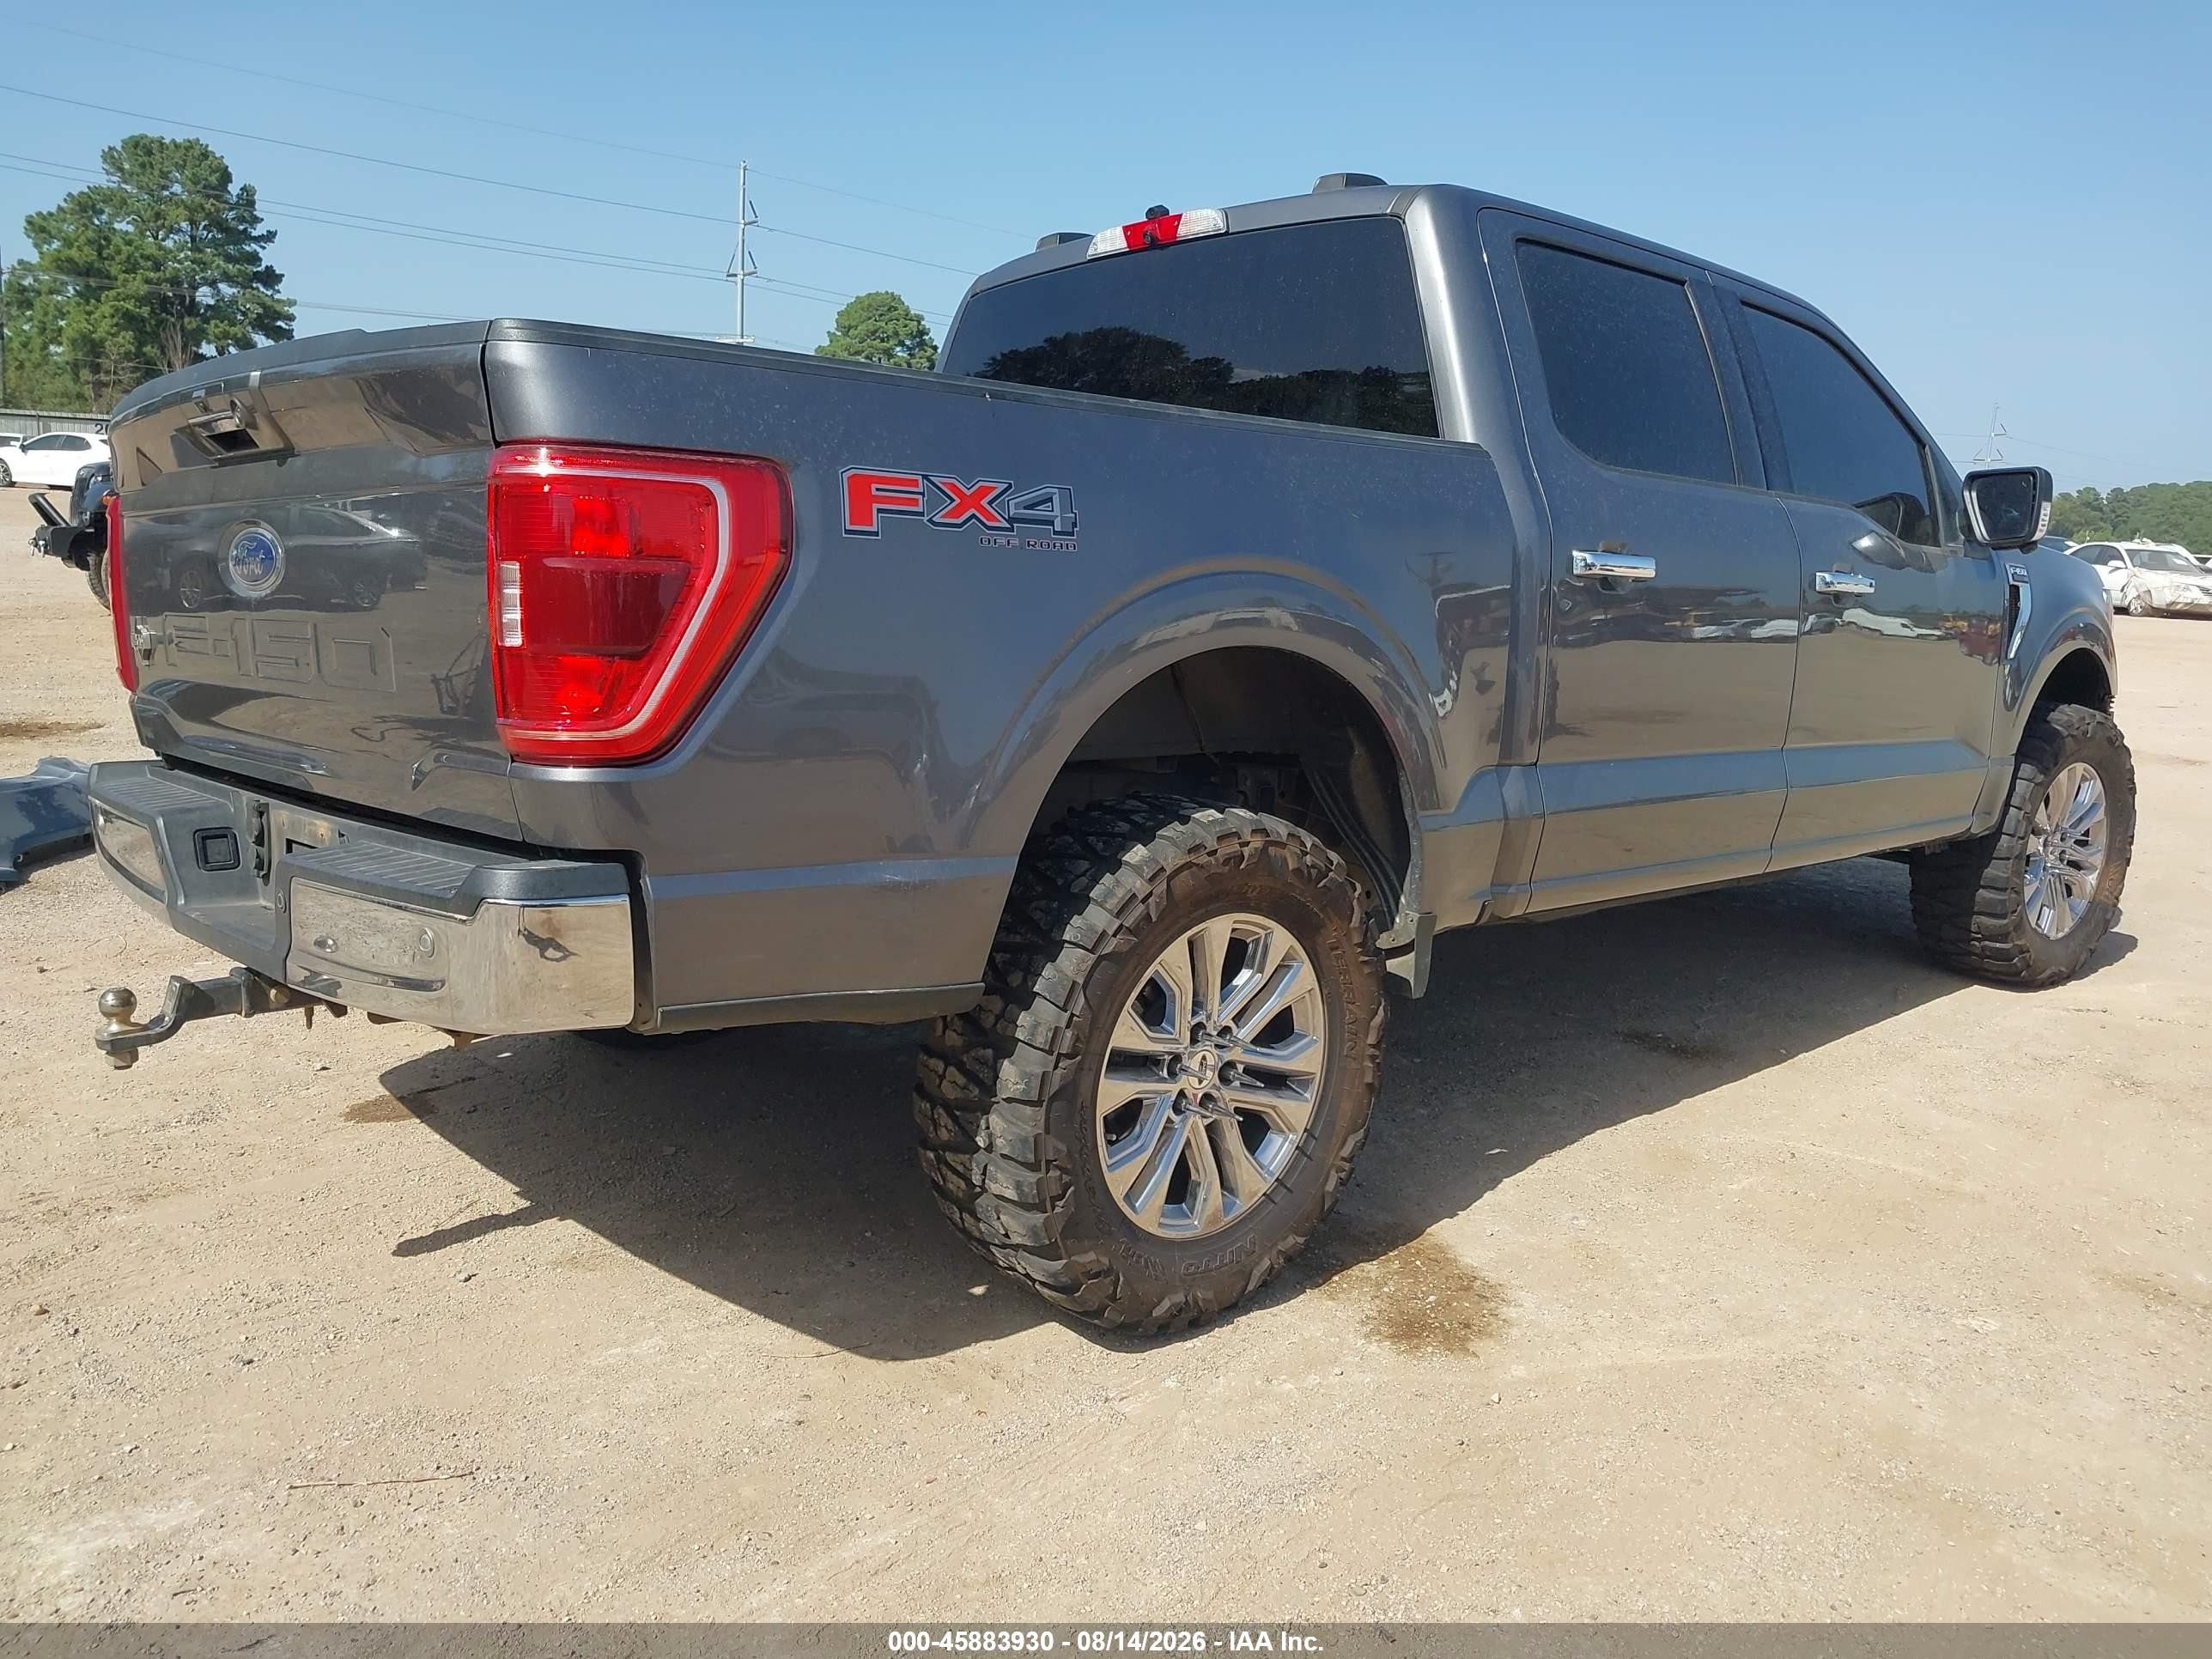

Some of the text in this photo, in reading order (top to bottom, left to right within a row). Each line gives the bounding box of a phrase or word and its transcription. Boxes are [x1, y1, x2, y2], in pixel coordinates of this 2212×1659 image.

[840, 465, 1079, 539] FX4
[979, 535, 1078, 552] OFF ROAD
[1182, 1234, 1258, 1278] NITTO
